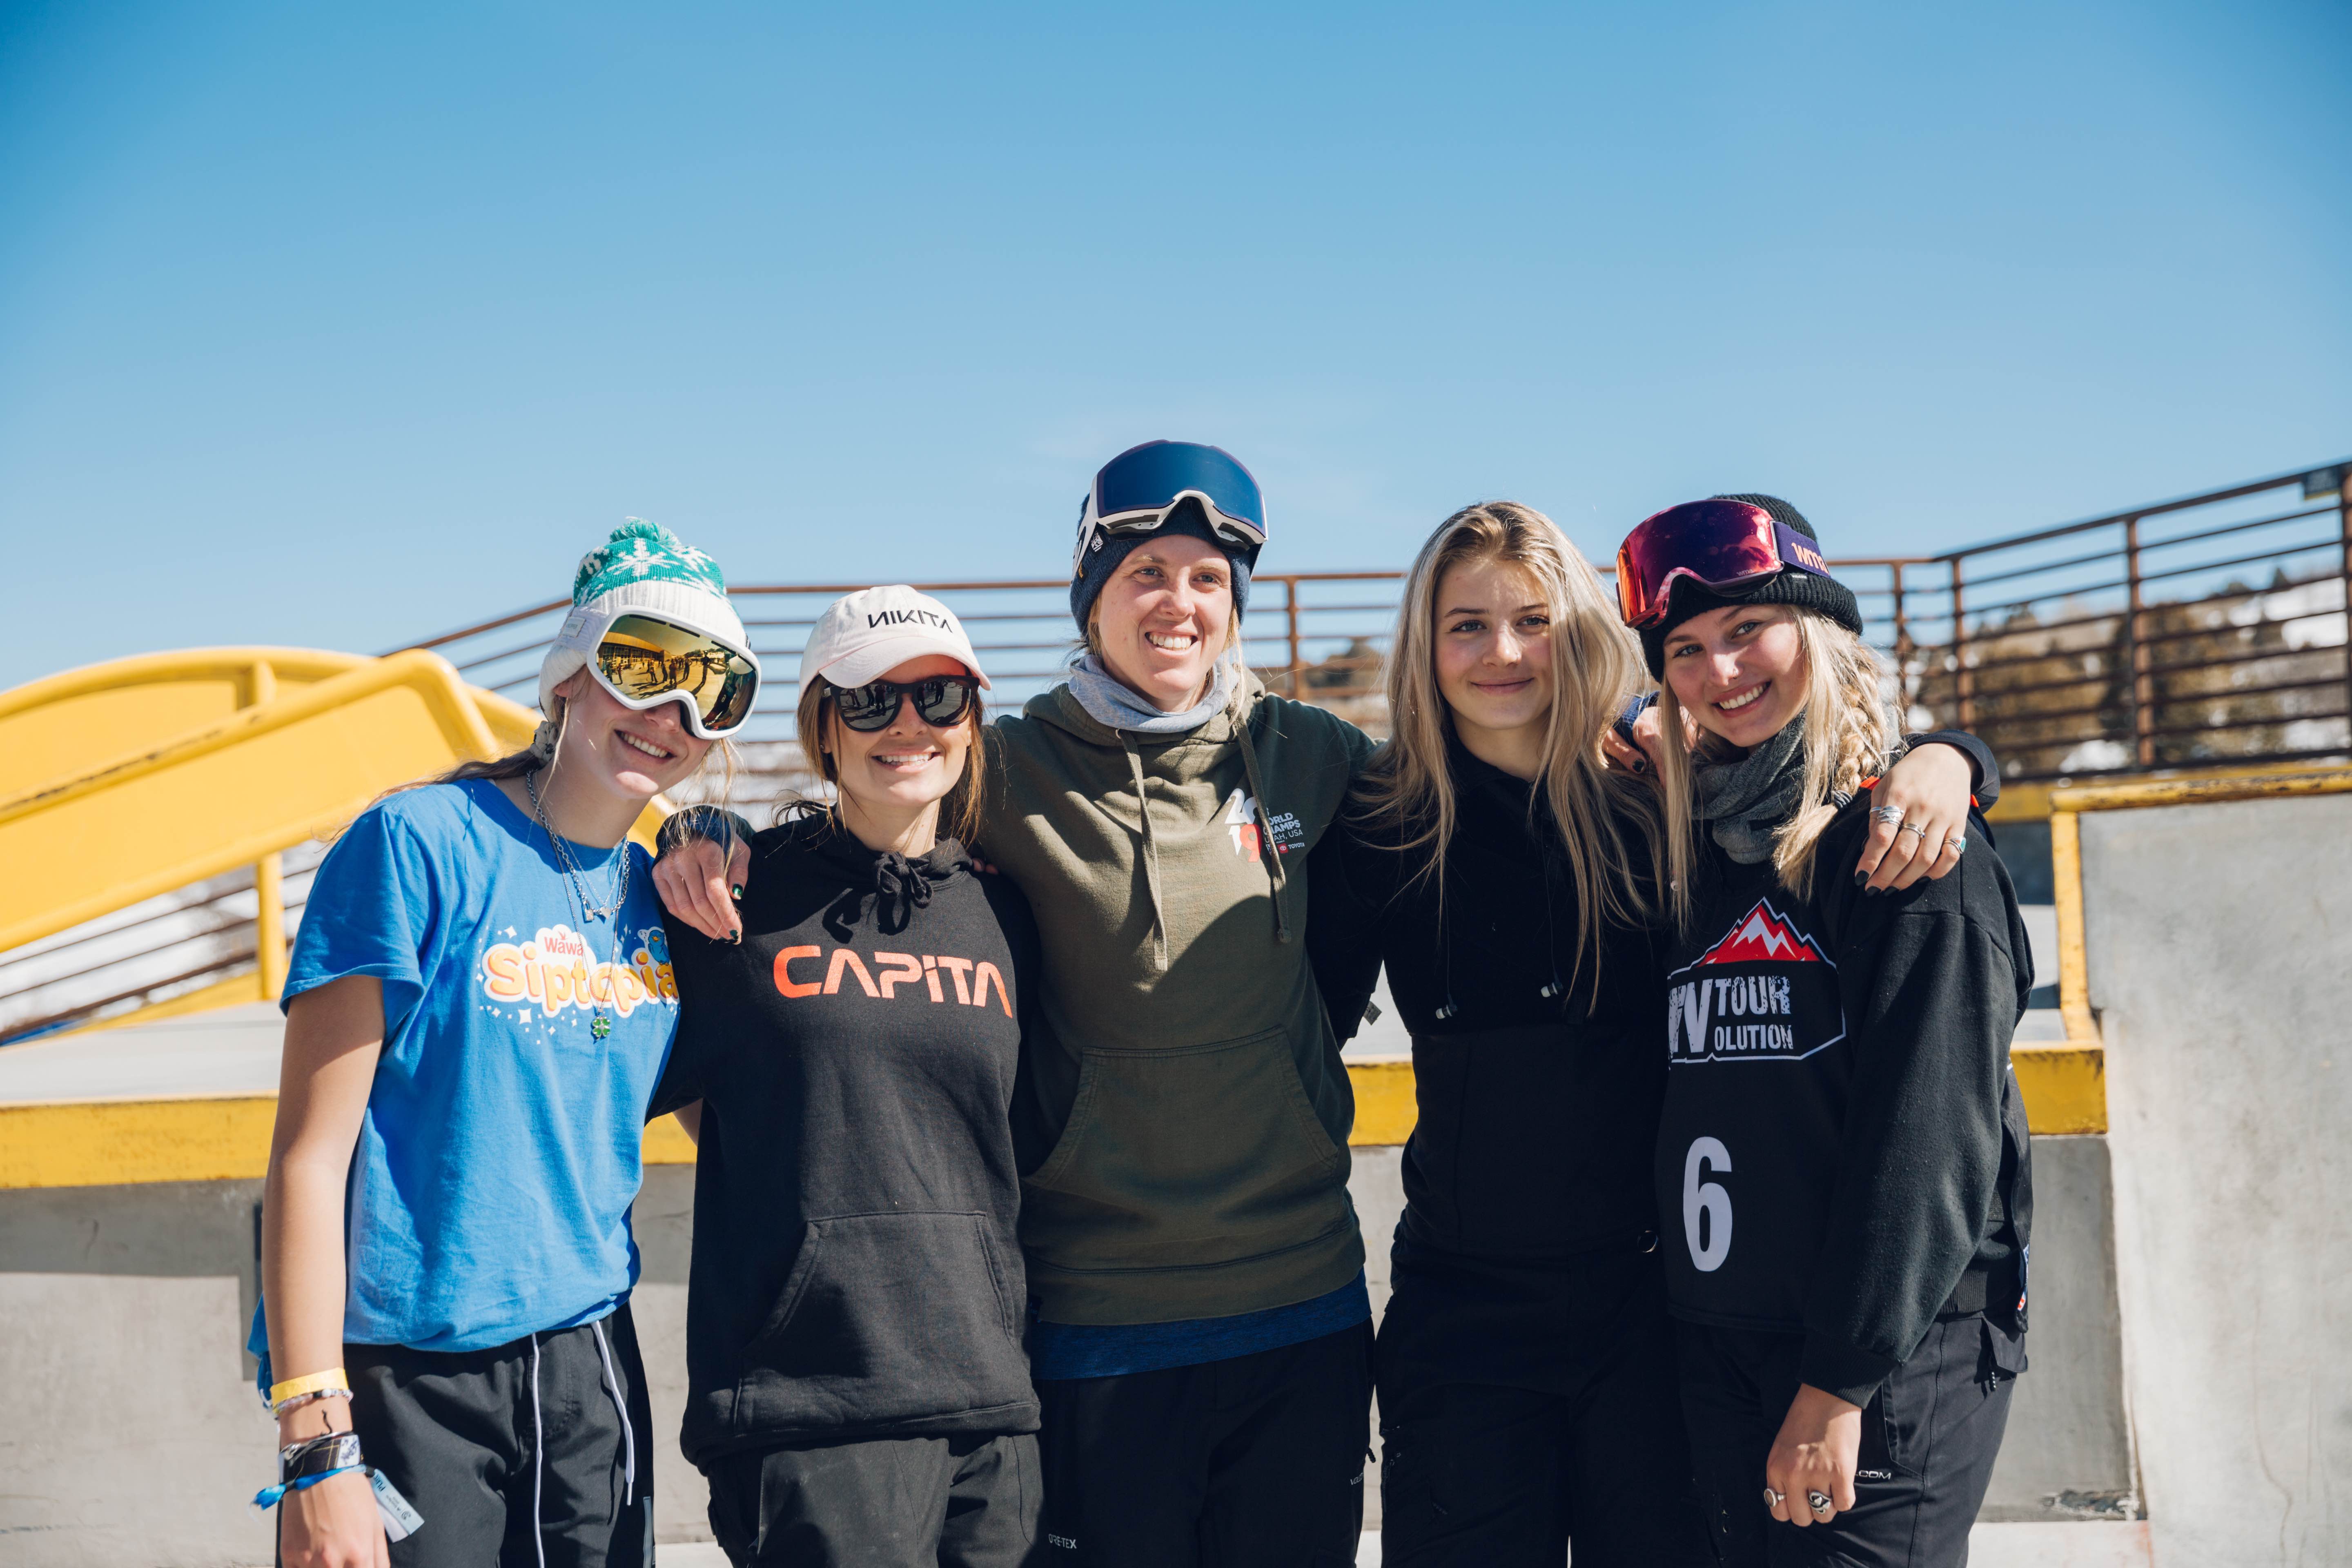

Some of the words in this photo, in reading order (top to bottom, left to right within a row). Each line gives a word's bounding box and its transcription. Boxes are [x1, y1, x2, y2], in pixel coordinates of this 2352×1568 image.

[1268, 813, 1293, 826] ORLD
[1288, 829, 1303, 837] USA
[544, 937, 584, 956] Wawa
[488, 946, 679, 1012] Siptopia
[1715, 976, 1791, 1016] TOUR
[1715, 1025, 1793, 1051] OLUTION
[1683, 1136, 1732, 1272] 6
[1855, 1470, 1891, 1480] COM
